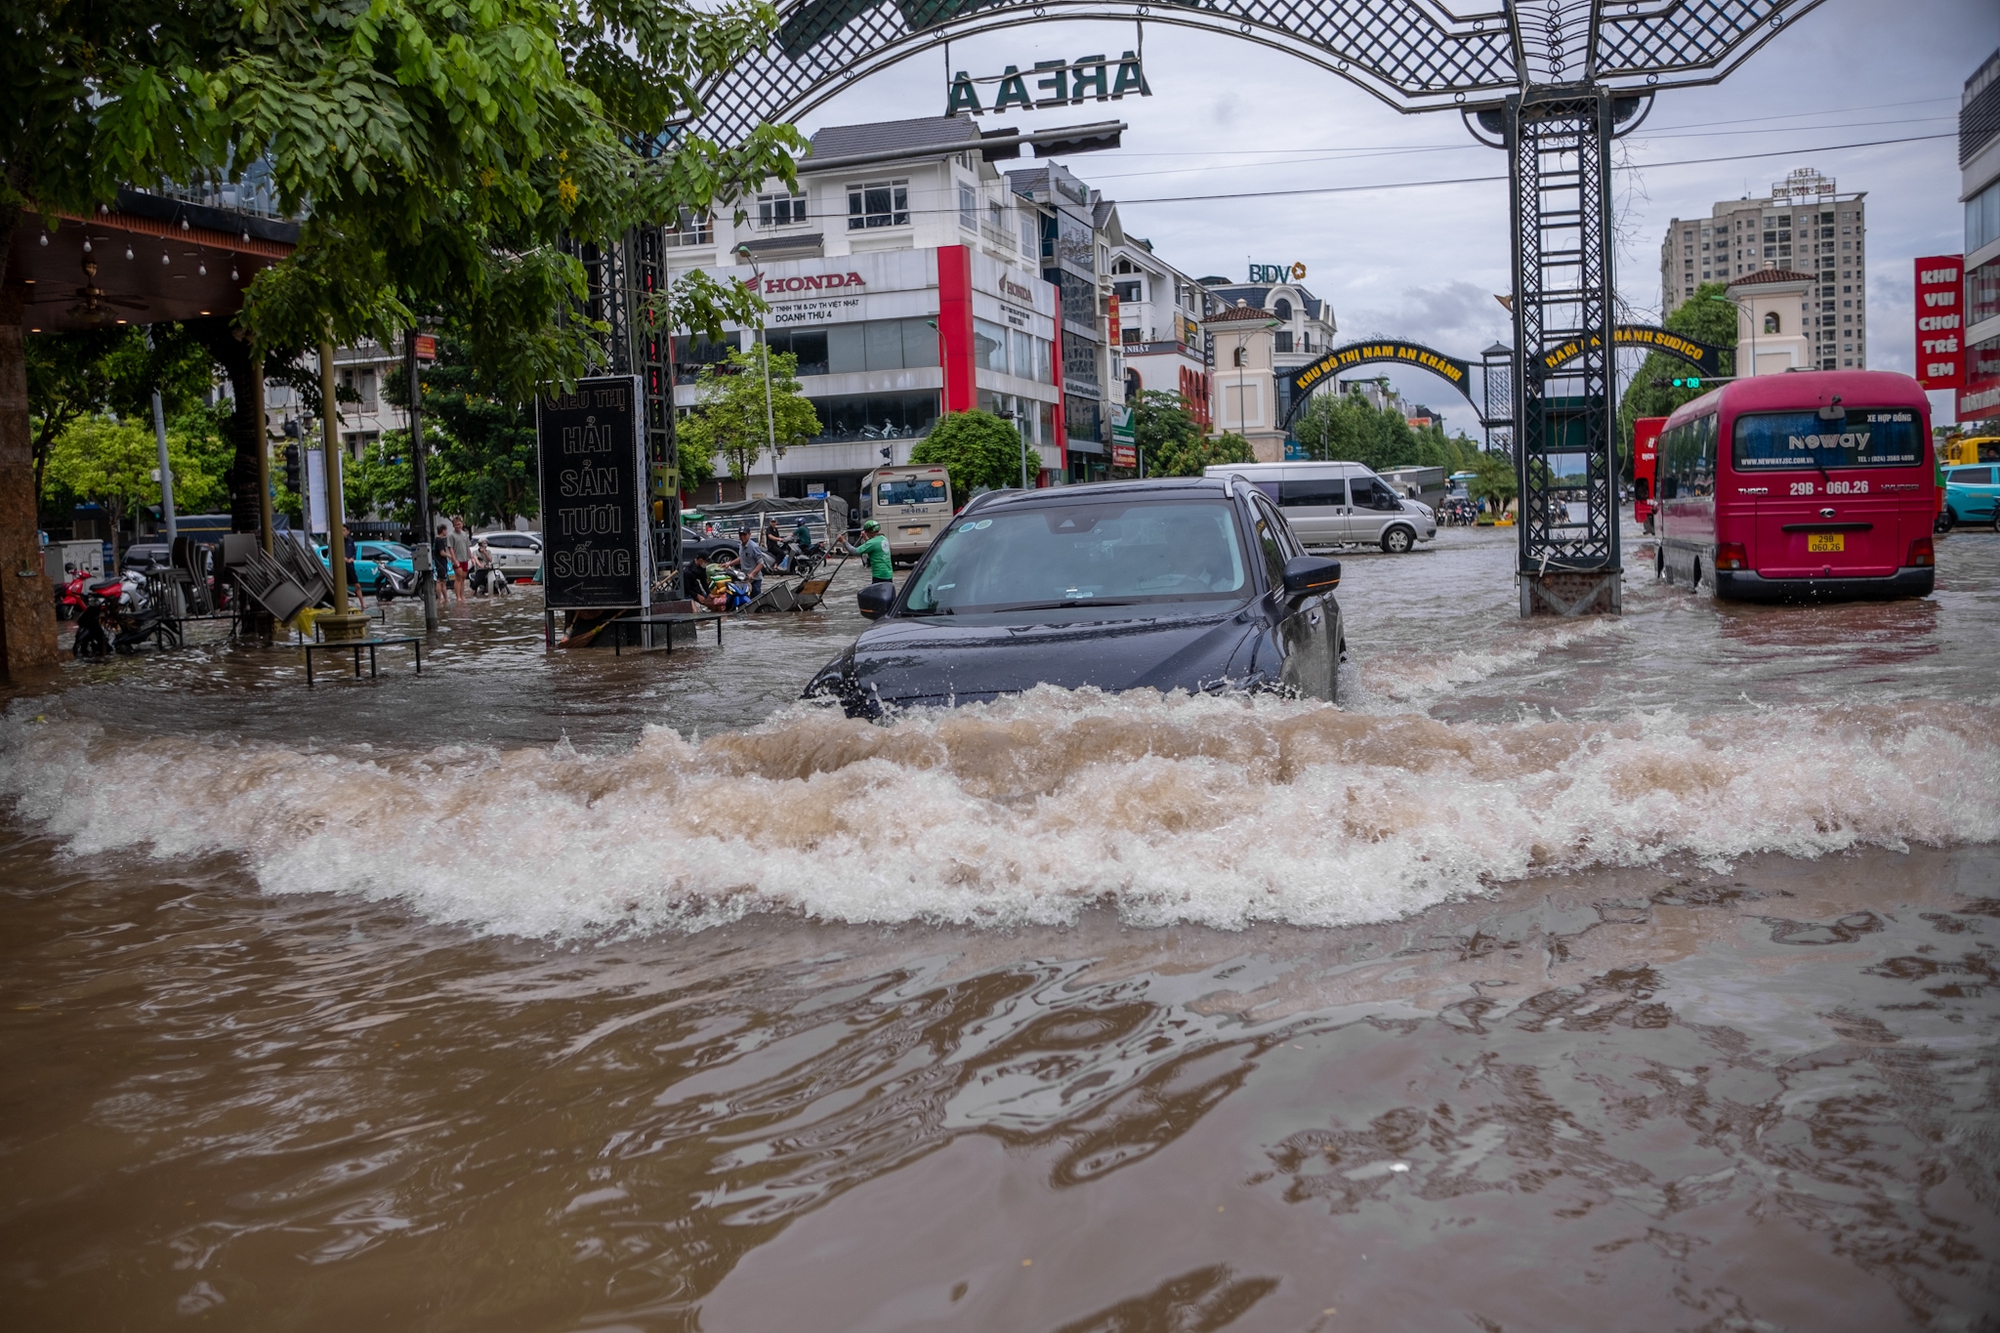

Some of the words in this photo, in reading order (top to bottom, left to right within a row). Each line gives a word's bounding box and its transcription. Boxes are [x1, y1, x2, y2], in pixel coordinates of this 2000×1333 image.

[764, 272, 866, 293] HONDA
[1249, 264, 1292, 284] BIDV
[1921, 268, 1958, 285] KHU
[1006, 281, 1033, 303] HONDA
[1924, 292, 1956, 307] VUI
[775, 312, 806, 323] DOANH
[807, 311, 825, 320] THU
[1918, 313, 1960, 331] CHƠI
[1545, 342, 1579, 368] NAM
[1613, 327, 1654, 343] HÁNH
[1654, 332, 1704, 361] SUDICO
[1922, 334, 1958, 354] TRẺ
[1296, 366, 1322, 390] KHU
[1320, 356, 1339, 374] ĐÔ
[1339, 349, 1361, 363] THỊ
[1362, 345, 1394, 359] NAM
[1398, 347, 1417, 361] AN
[1418, 351, 1463, 382] KHÁNH
[1927, 362, 1954, 377] EM
[594, 387, 625, 412] THỊ
[1867, 414, 1876, 423] XE
[562, 416, 612, 454] HẢI
[560, 459, 619, 497] SẢN
[1789, 481, 1814, 496] 29B
[1826, 480, 1869, 495] 060.26
[1737, 487, 1769, 495] THACO
[558, 503, 622, 536] TƯƠI
[1812, 543, 1840, 552] 060.26
[1818, 535, 1834, 543] 29B
[553, 541, 631, 578] SỐNG
